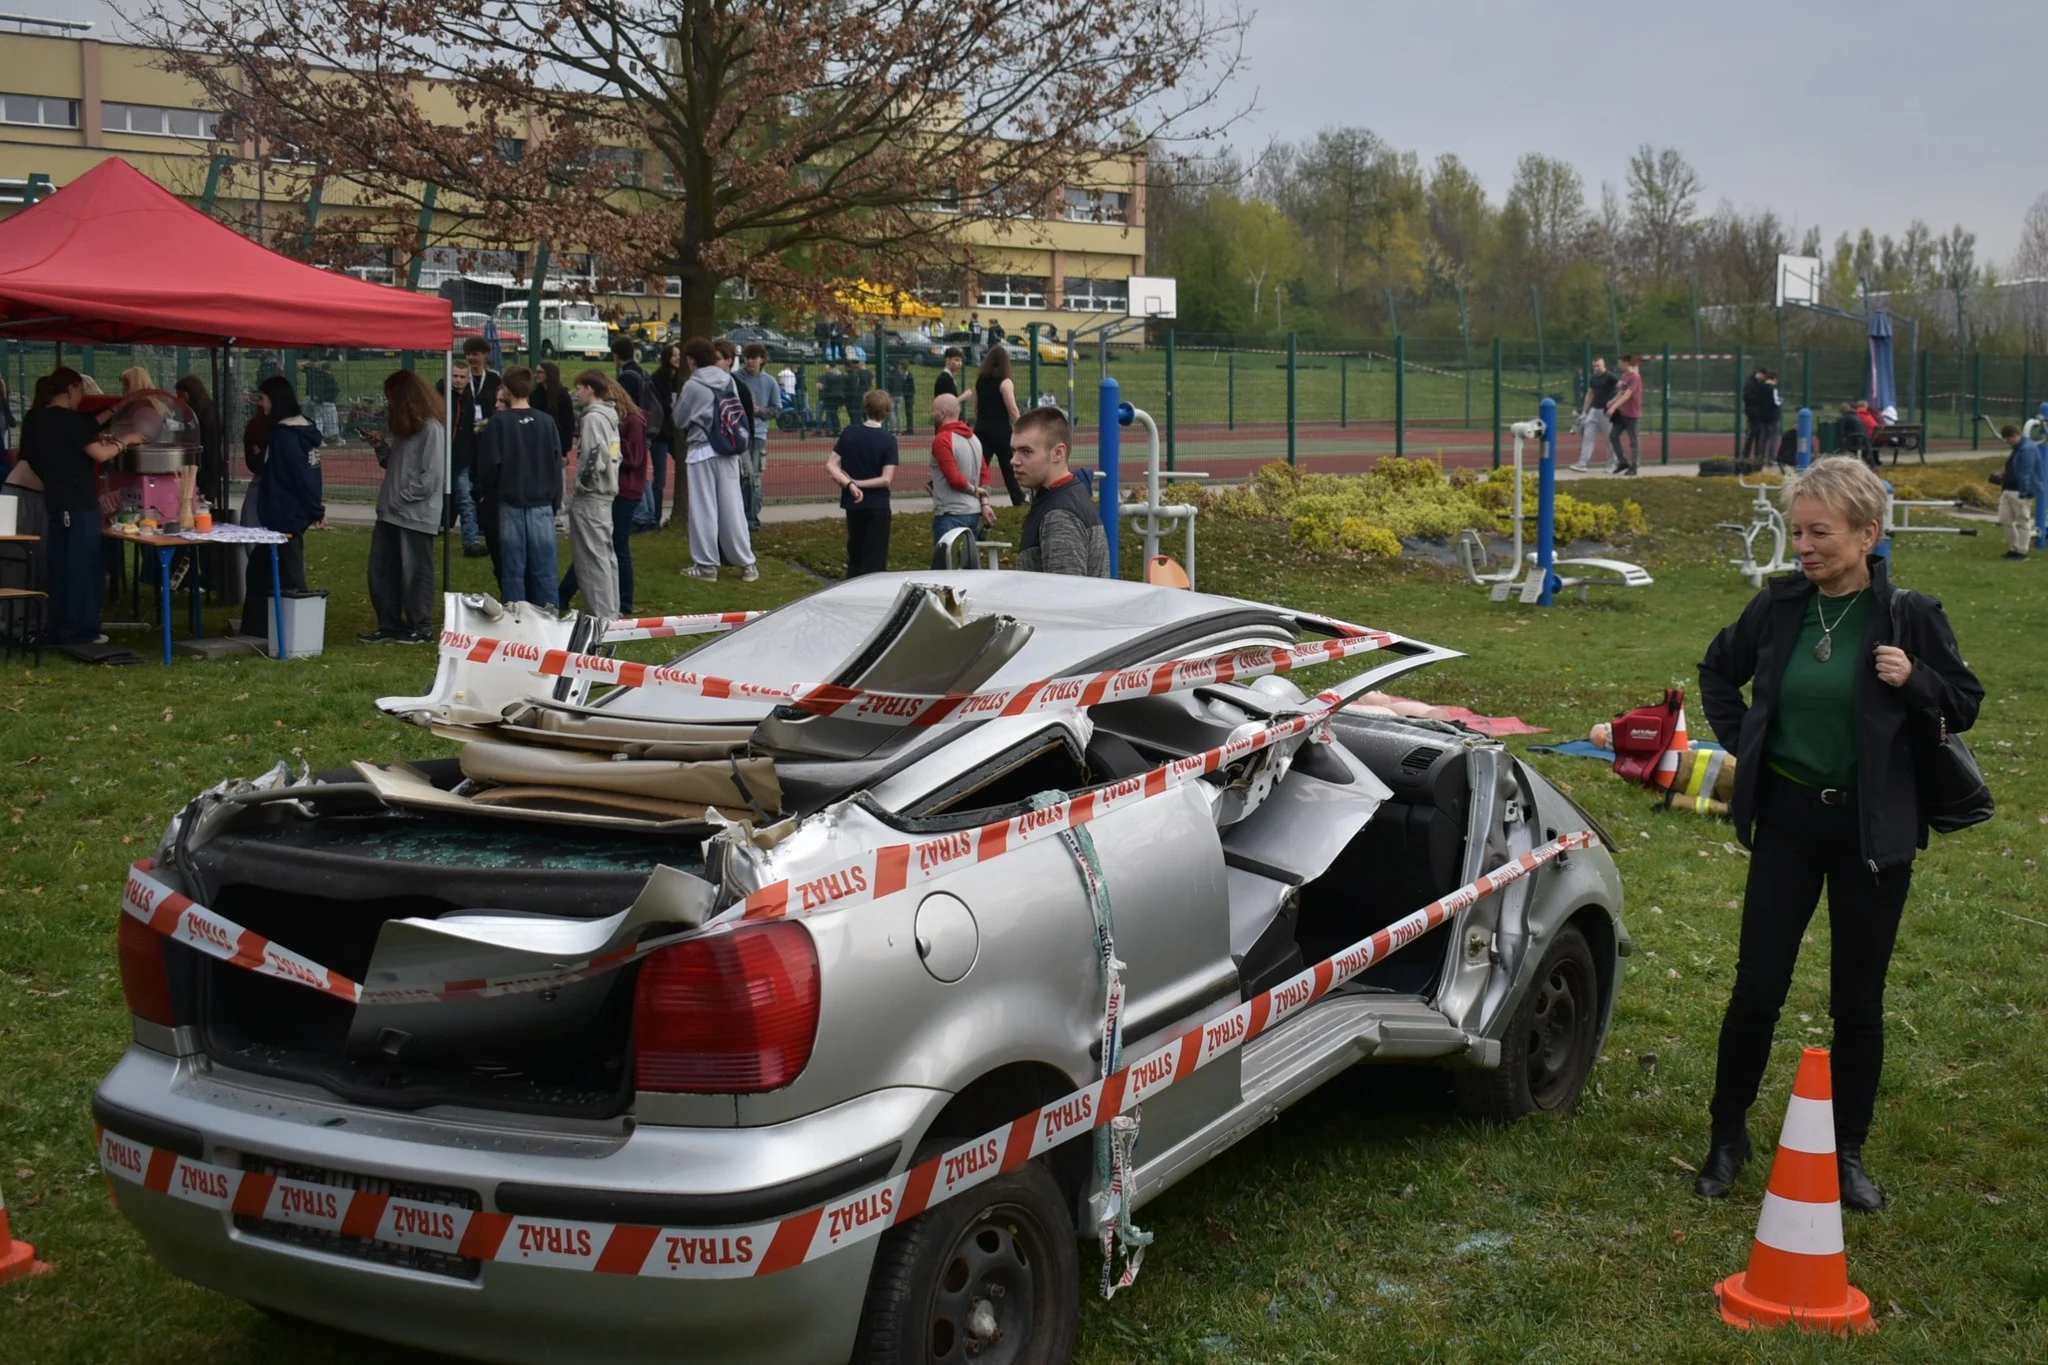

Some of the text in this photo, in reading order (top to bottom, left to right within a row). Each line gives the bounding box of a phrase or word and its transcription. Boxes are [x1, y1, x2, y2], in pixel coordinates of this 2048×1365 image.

[502, 641, 539, 662] STRAŻ
[575, 654, 614, 674] STRAŻ
[1113, 668, 1151, 697] STRAŻ
[1179, 657, 1211, 684] STRAŻ
[858, 690, 923, 718] STRAŻ
[960, 691, 1010, 718] STRAŻ
[1040, 680, 1084, 709] STRAŻ
[1019, 805, 1063, 840] STRAŻ
[916, 831, 972, 876] STRAŻ
[796, 864, 867, 915] STRAŻ
[187, 912, 233, 950] STRAŻ
[1336, 947, 1368, 980] STRAŻ
[1275, 980, 1309, 1019] STRAŻ
[1207, 1014, 1244, 1057] STRAŻ
[1132, 1051, 1173, 1098] STRAŻ
[1043, 1093, 1092, 1143] STRAŻ
[105, 1137, 142, 1173] STRAŻ
[945, 1138, 998, 1191] STRAŻ
[180, 1165, 228, 1199] STRAŻ
[280, 1185, 338, 1221] STRAŻ
[828, 1187, 893, 1244] STRAŻ
[392, 1205, 454, 1240] STRAŻ
[517, 1224, 592, 1257] STRAŻ
[666, 1236, 753, 1271] STRAŻ
